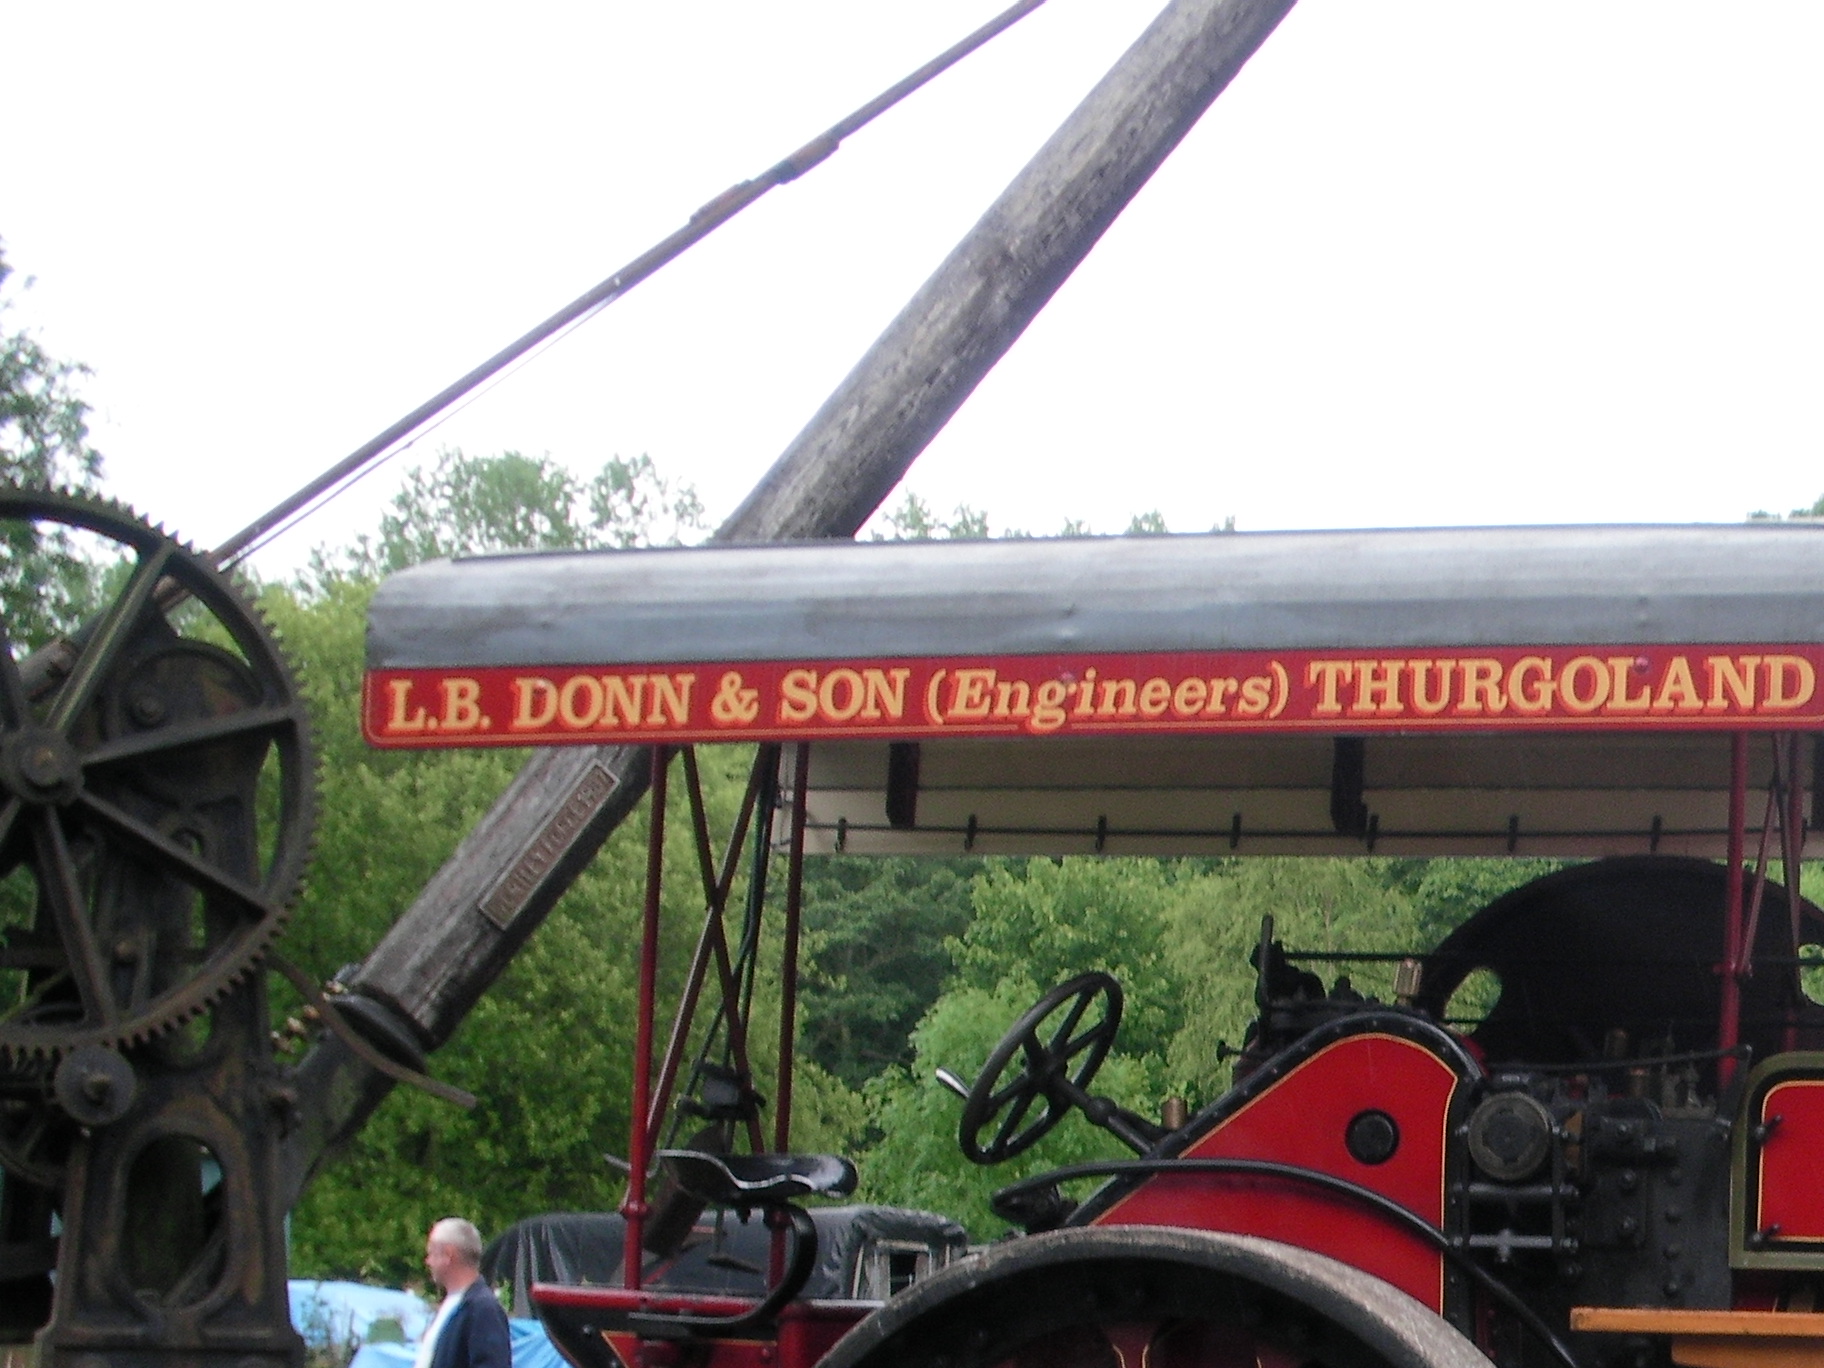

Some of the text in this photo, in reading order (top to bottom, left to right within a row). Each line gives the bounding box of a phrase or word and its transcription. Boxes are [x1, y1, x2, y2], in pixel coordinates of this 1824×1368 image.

[386, 655, 1816, 731] L.B. DONN & SON (Engineers) THURGOLAND
